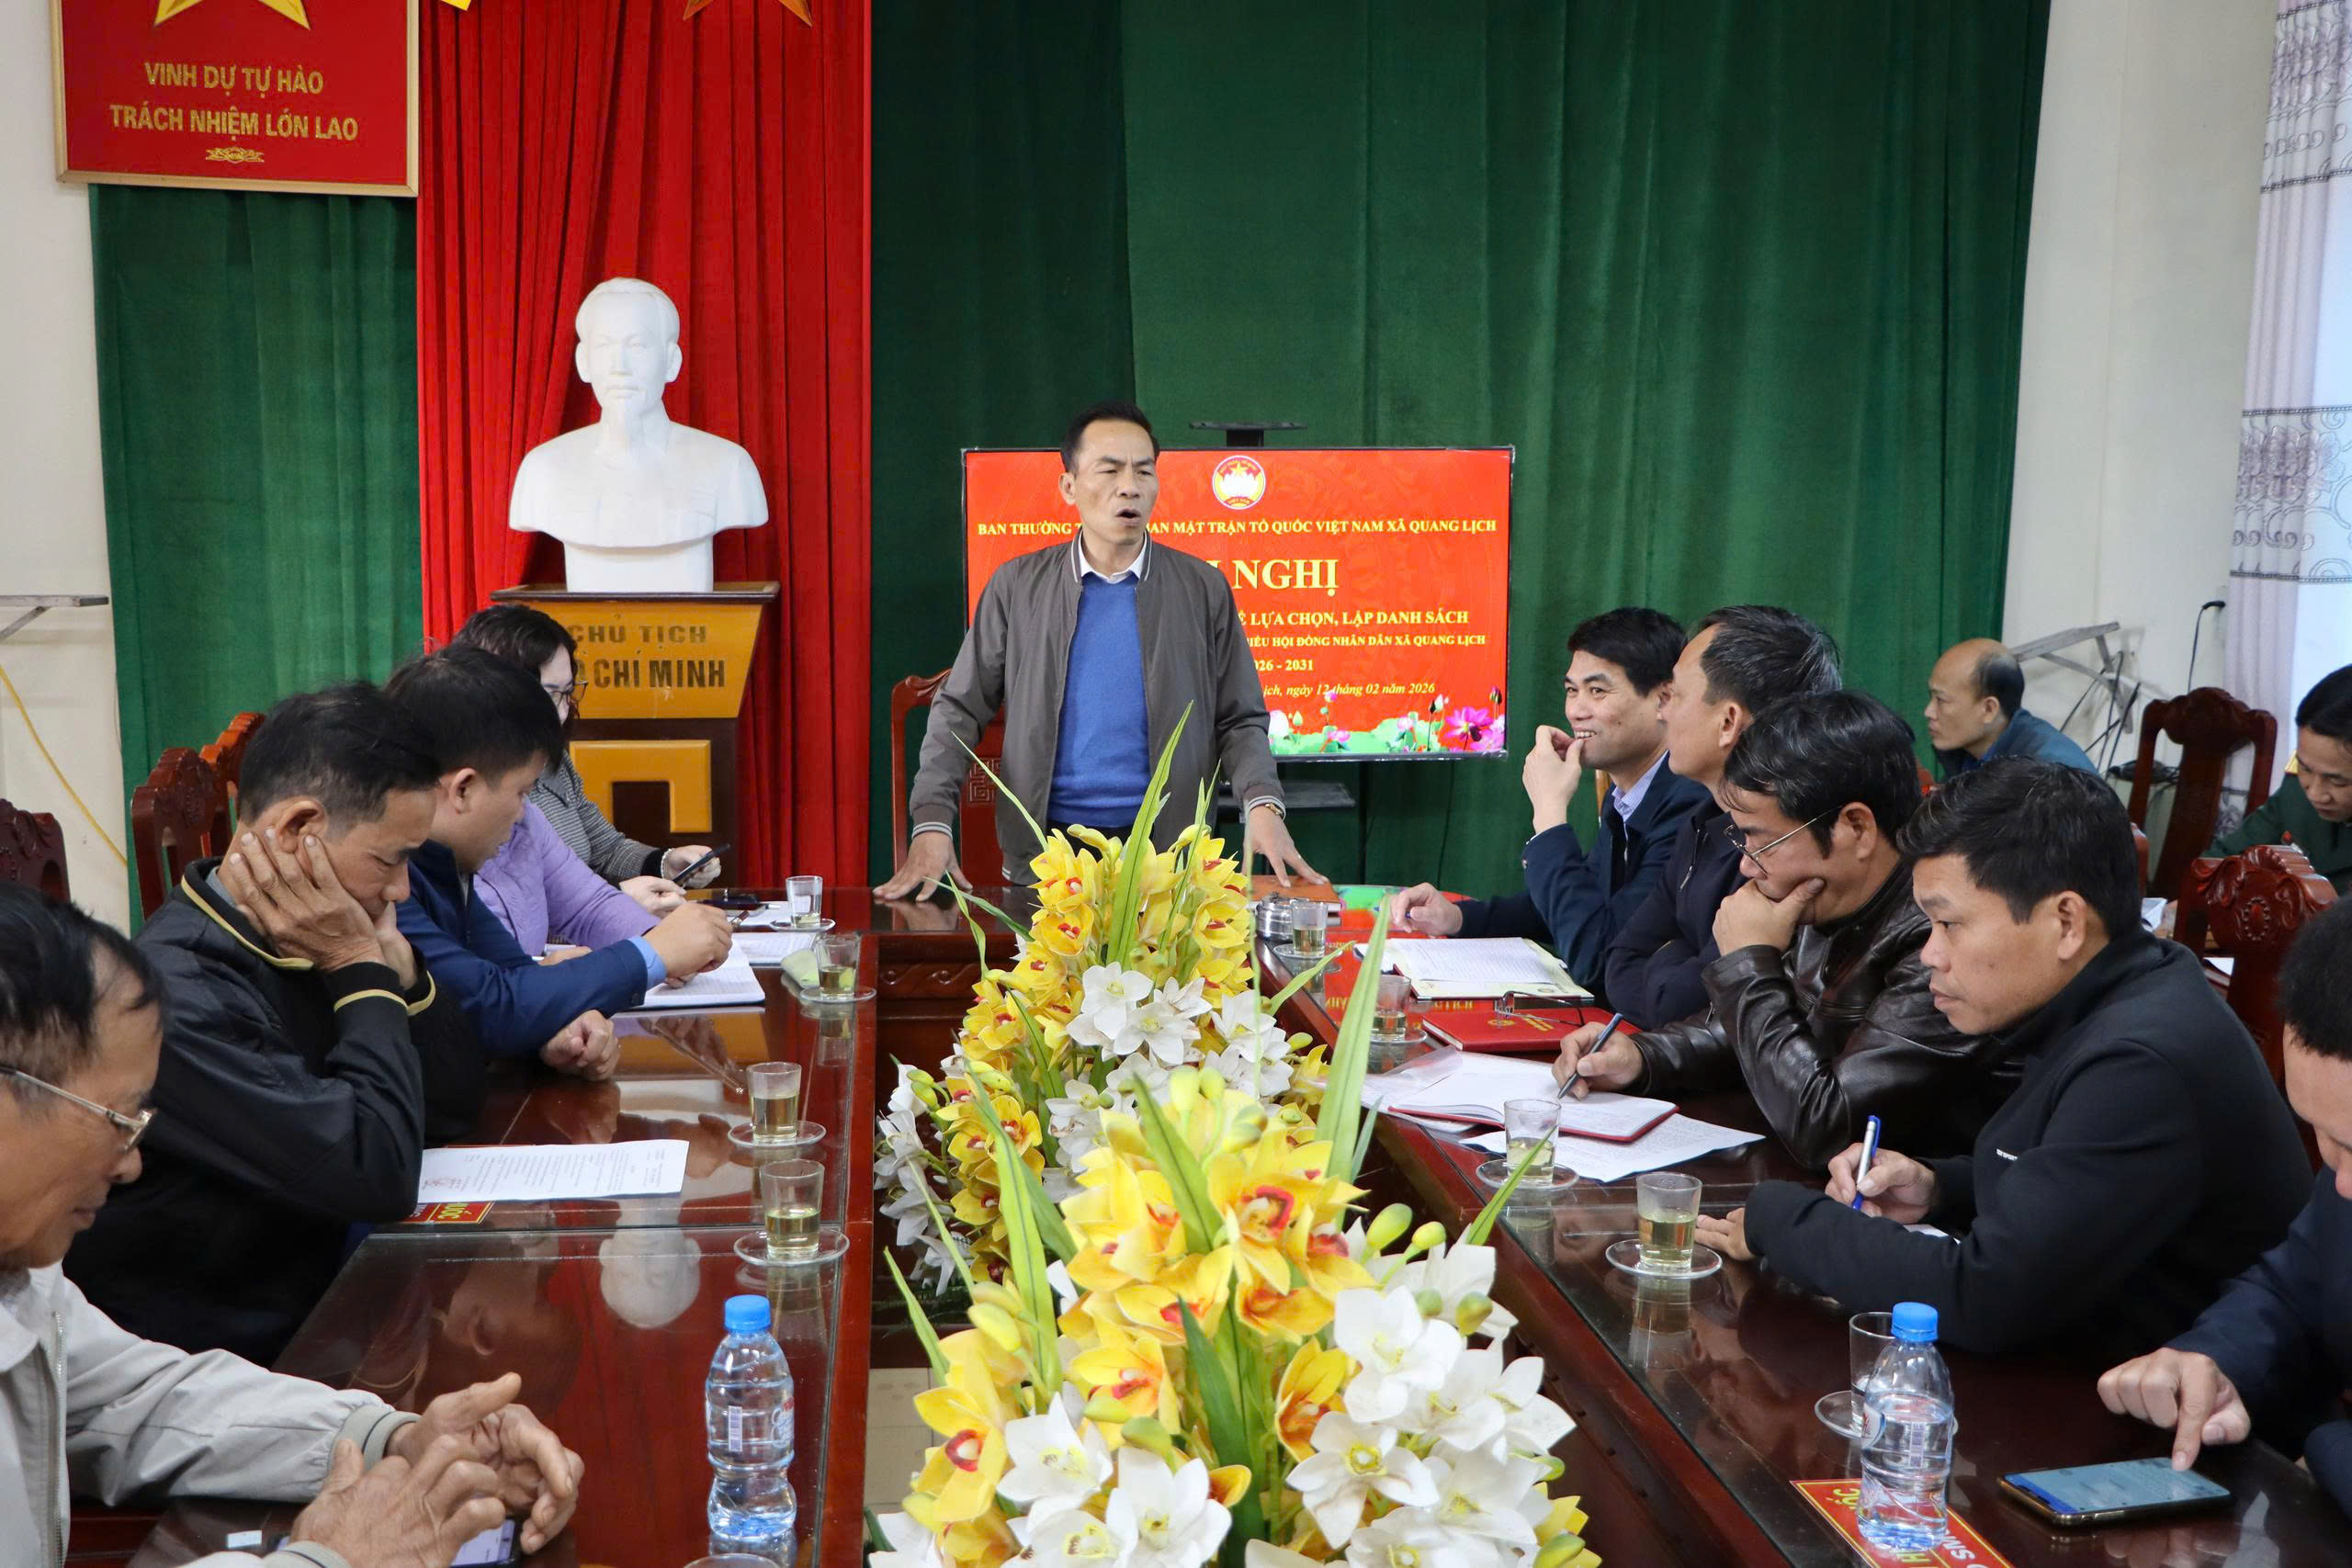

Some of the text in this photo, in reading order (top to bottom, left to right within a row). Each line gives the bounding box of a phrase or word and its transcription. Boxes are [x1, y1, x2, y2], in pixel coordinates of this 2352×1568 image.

[144, 62, 323, 98] VINH DỰ TỰ HÀO
[109, 100, 359, 141] TRÁCH NHIỆM LỚN LAO
[978, 523, 1007, 535] BAN
[1010, 520, 1072, 536] THƯỜNG
[1207, 520, 1246, 536] TRẬN
[1272, 518, 1313, 536] QUỐC
[1316, 519, 1349, 536] VIỆT
[1351, 521, 1385, 533] NAM
[1387, 517, 1407, 533] XÃ
[1409, 520, 1459, 535] QUANG
[1463, 519, 1497, 535] LỊCH
[1232, 558, 1339, 597] NGHỊ
[567, 613, 707, 649] CHỦ TỊCH
[1250, 610, 1284, 629] LỰA
[1287, 611, 1339, 628] CHỌN,
[1342, 610, 1374, 628] LẬP
[1376, 611, 1422, 625] DANH
[1425, 607, 1469, 625] SÁCH
[1247, 635, 1270, 648] IỂU
[1272, 635, 1294, 649] HỘI
[1333, 633, 1366, 647] NHÂN
[1368, 633, 1393, 647] DÂN
[1413, 635, 1454, 648] QUANG
[1457, 635, 1486, 648] LỊCH
[594, 649, 640, 688] CHÍ
[649, 660, 725, 688] MINH
[1285, 659, 1314, 671] 2031
[1263, 683, 1283, 698] ịch,
[1286, 683, 1314, 699] ngày
[1331, 683, 1363, 698] tháng
[1365, 682, 1380, 694] 02
[1382, 683, 1406, 694] năm
[1408, 682, 1436, 694] 2026
